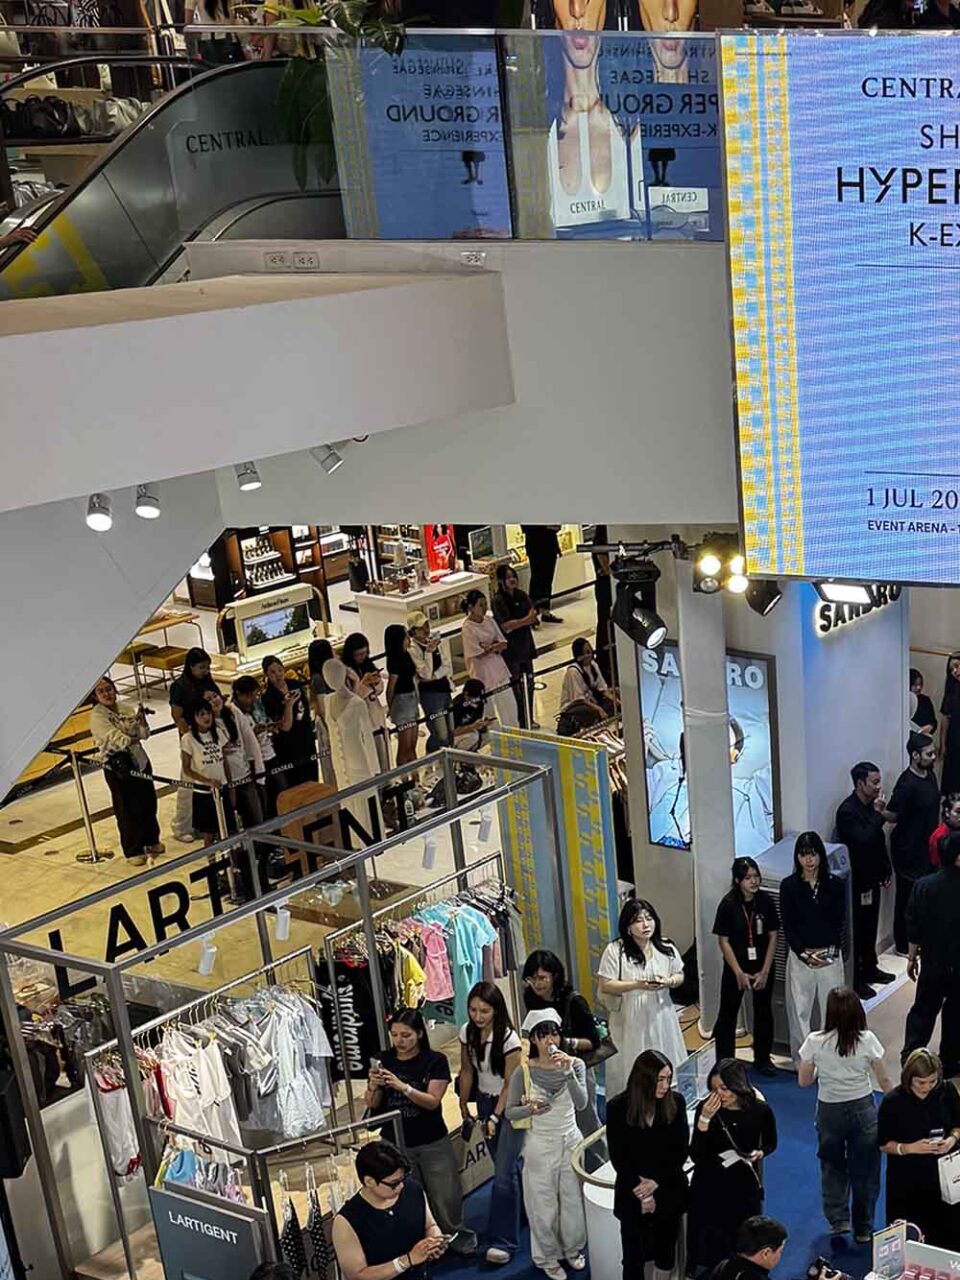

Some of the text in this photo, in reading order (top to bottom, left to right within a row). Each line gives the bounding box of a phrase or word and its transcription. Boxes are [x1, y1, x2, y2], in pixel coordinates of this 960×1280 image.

[186, 129, 270, 154] CENTRAL
[570, 199, 607, 215] CENTRAL
[866, 487, 875, 507] 1
[882, 488, 924, 510] JUL
[867, 520, 906, 533] EVENT
[907, 521, 948, 534] ARENA
[641, 649, 765, 690] SARO
[168, 1210, 239, 1245] LARTIGENT
